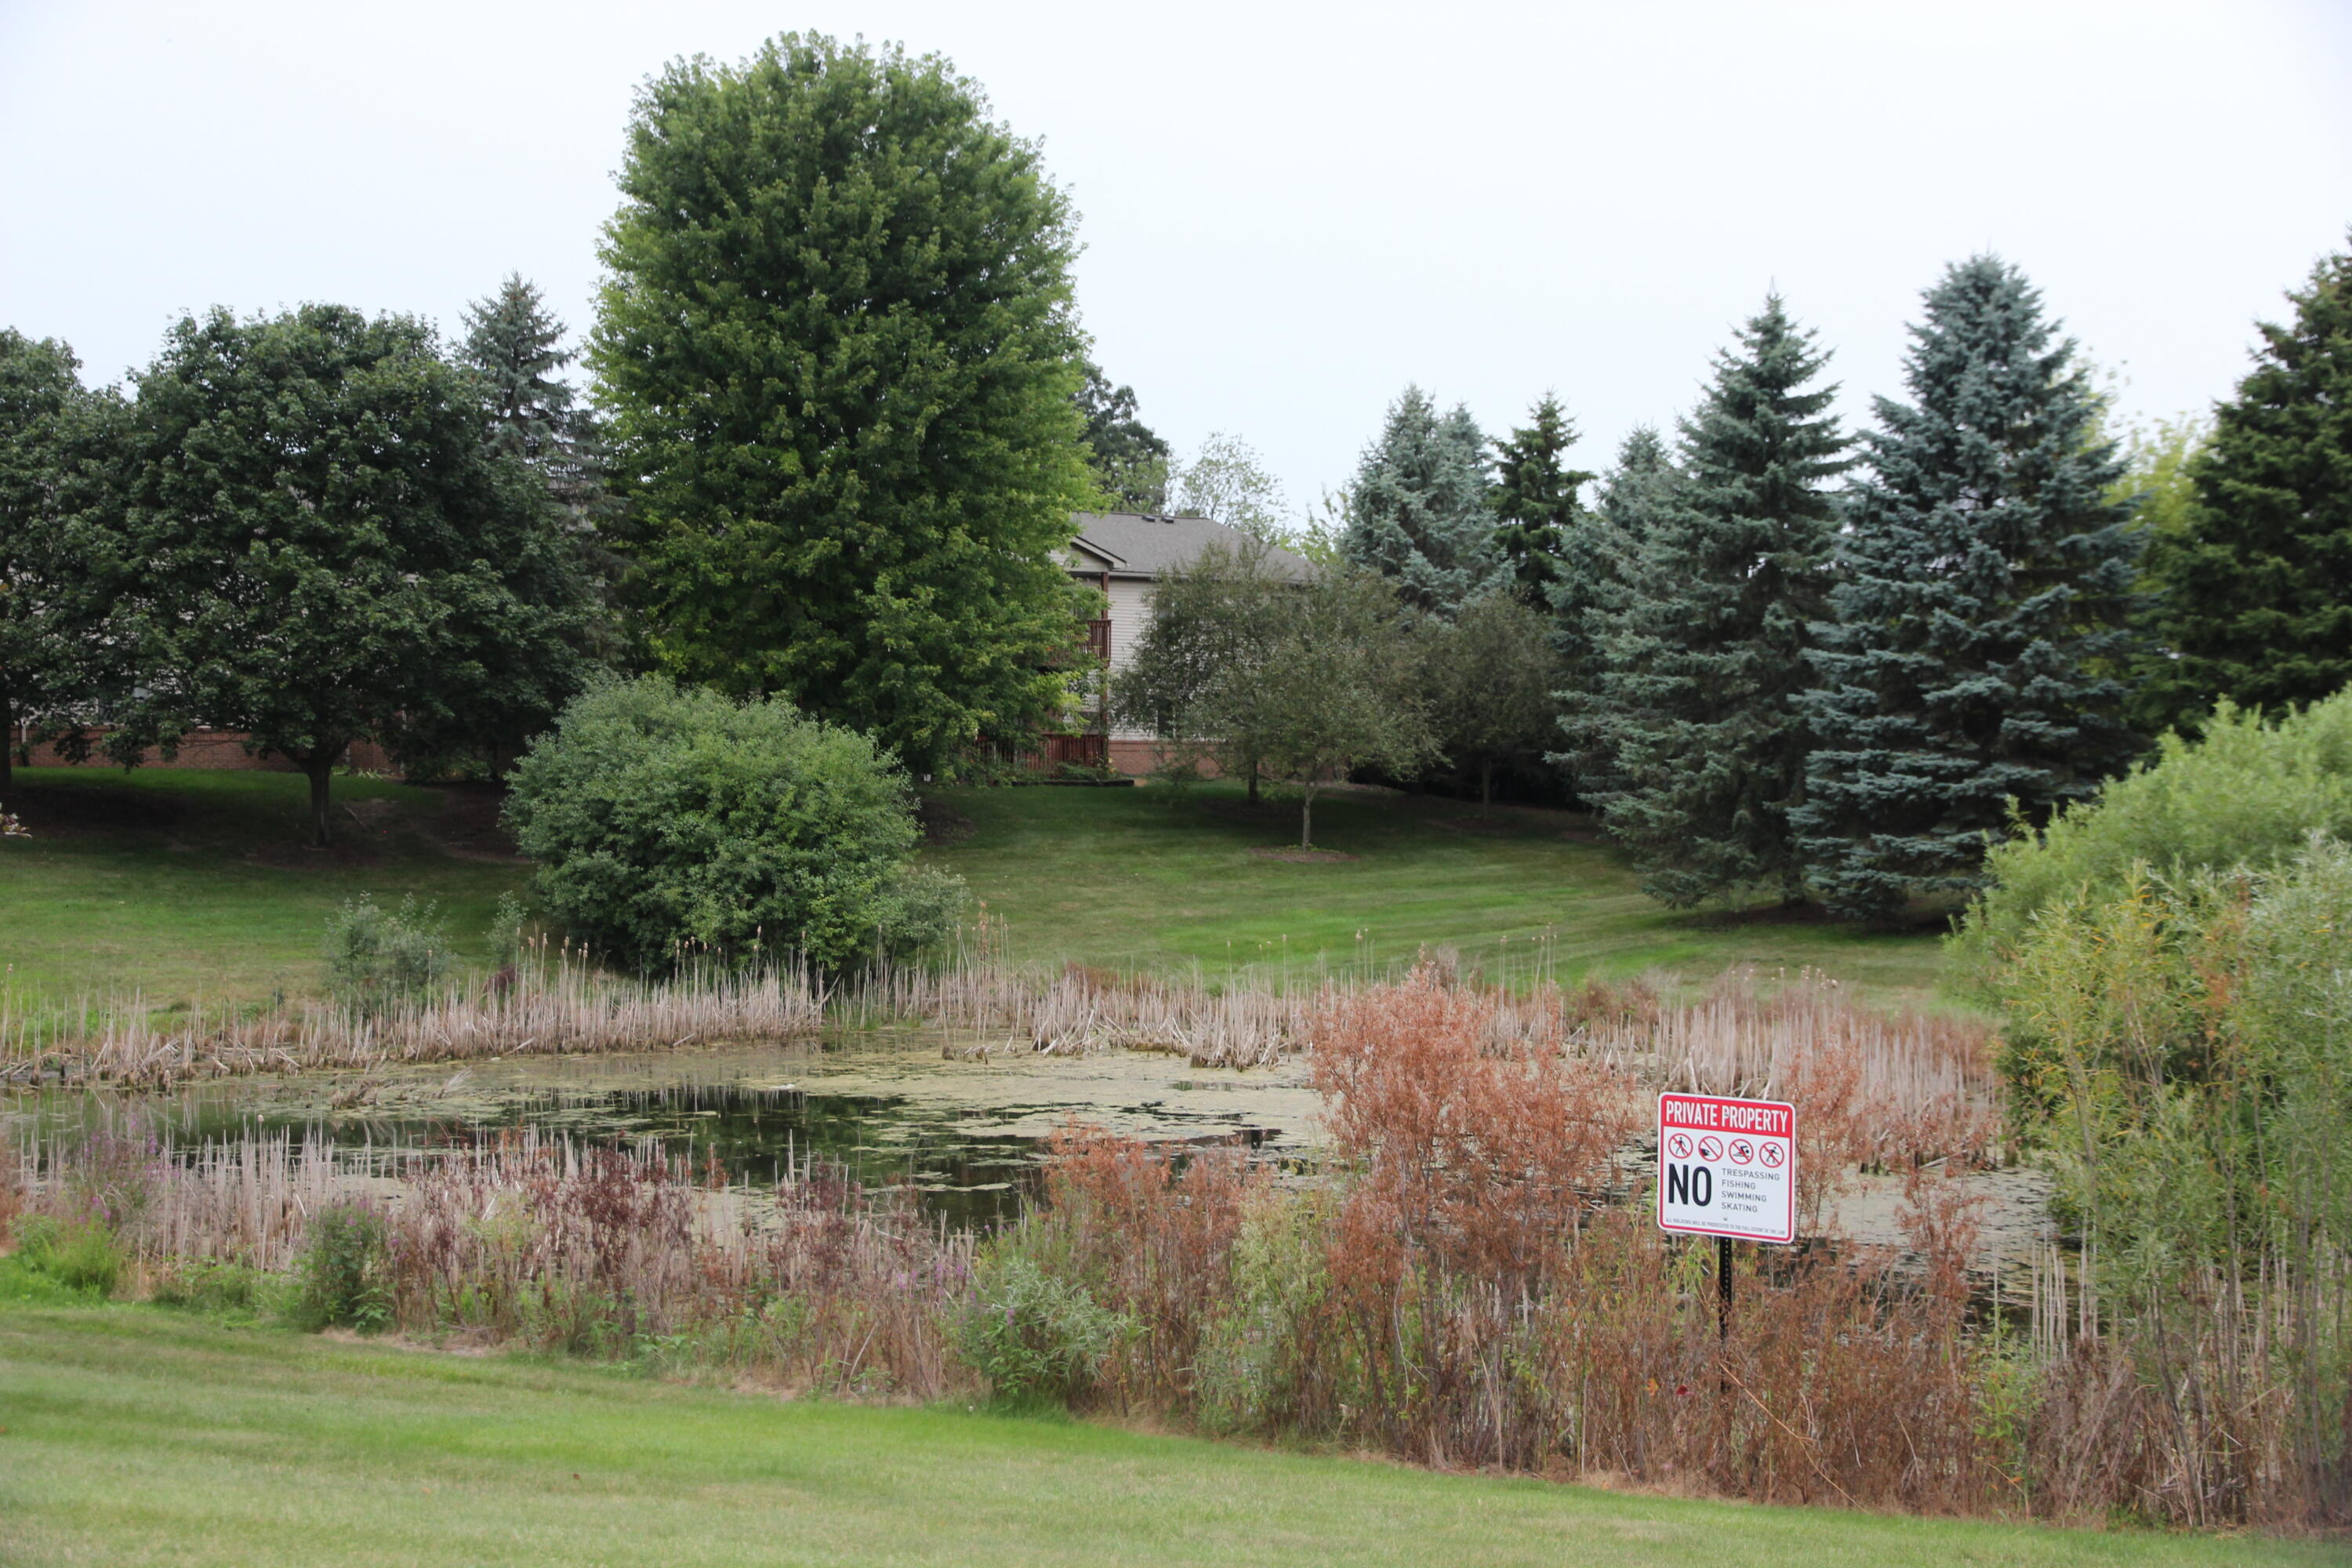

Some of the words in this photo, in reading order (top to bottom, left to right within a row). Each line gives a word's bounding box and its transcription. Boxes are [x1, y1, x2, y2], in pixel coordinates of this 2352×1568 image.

[1666, 1100, 1718, 1127] PRIVATE
[1722, 1105, 1788, 1133] PROPERTY
[1722, 1167, 1780, 1181] TRESPASSING
[1668, 1163, 1712, 1207] NO
[1722, 1179, 1756, 1190] FISHING
[1721, 1190, 1767, 1203] SWIMMING
[1721, 1202, 1758, 1213] SKATING
